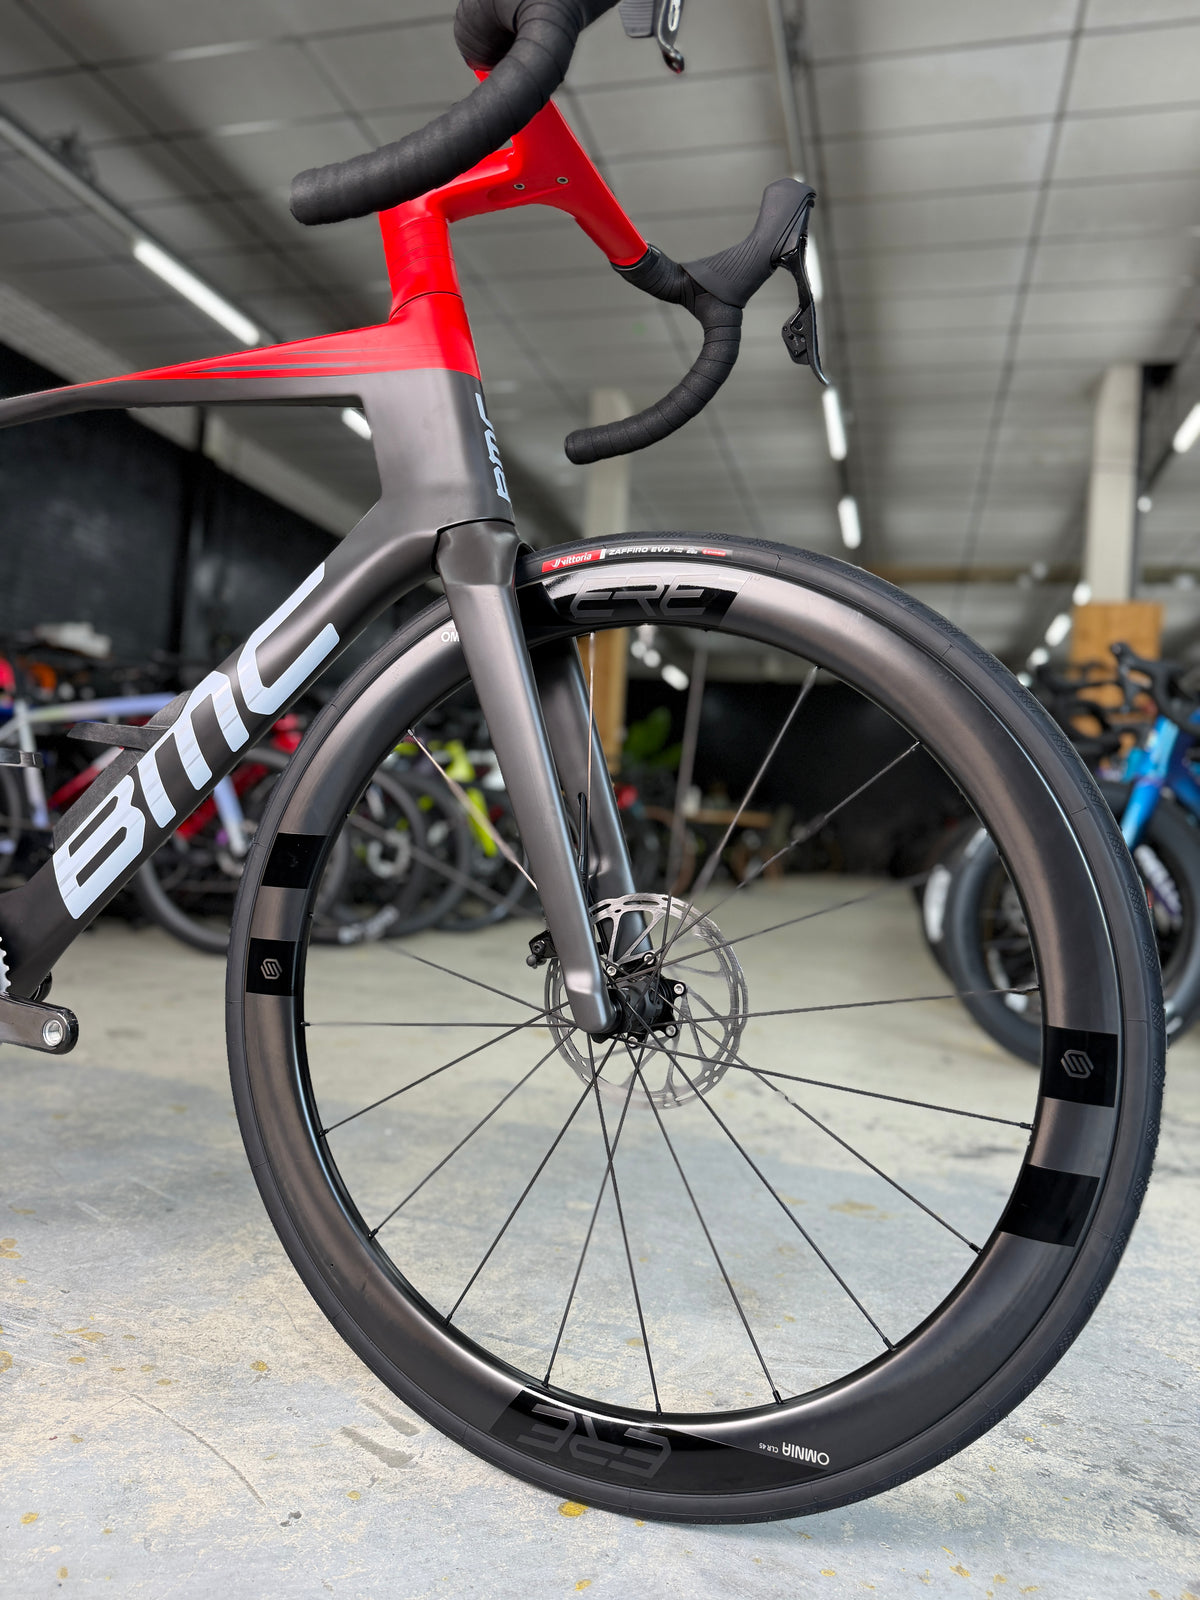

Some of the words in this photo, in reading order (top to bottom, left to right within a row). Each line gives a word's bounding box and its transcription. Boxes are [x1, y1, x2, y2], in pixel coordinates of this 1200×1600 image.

[608, 547, 648, 556] ZAFFIRO
[560, 552, 592, 566] vittoria
[569, 573, 720, 619] ERE
[515, 1403, 672, 1478] ERE
[758, 1442, 767, 1450] 45
[766, 1444, 779, 1454] CLR
[782, 1441, 830, 1466] OMNIA
